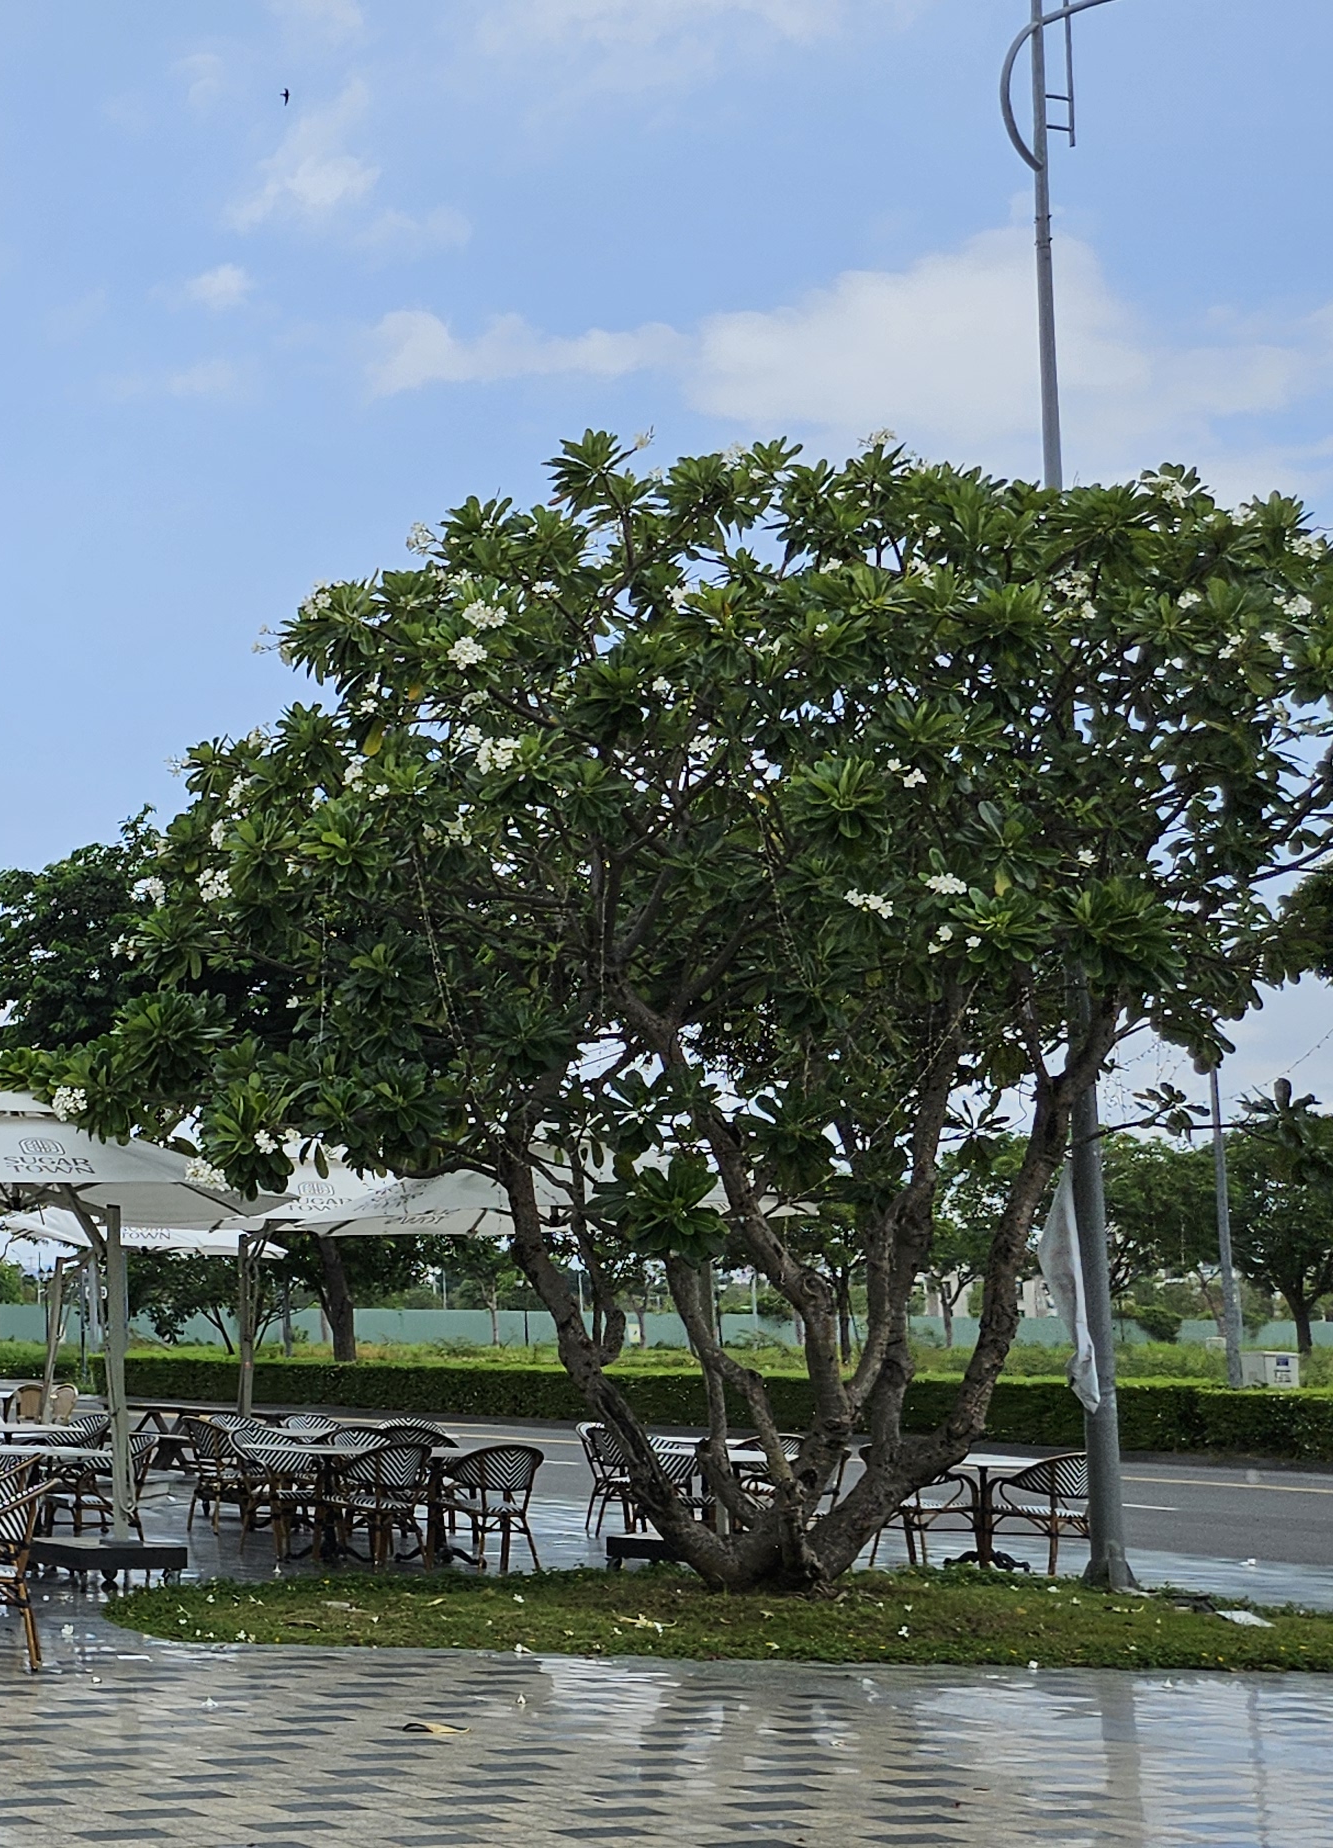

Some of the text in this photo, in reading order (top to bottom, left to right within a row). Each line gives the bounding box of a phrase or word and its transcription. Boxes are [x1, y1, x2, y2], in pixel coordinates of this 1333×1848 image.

[3, 1156, 91, 1167] SUGAR
[6, 1164, 96, 1174] TOWN
[288, 1203, 337, 1212] TOW
[122, 1232, 171, 1240] TOWN
